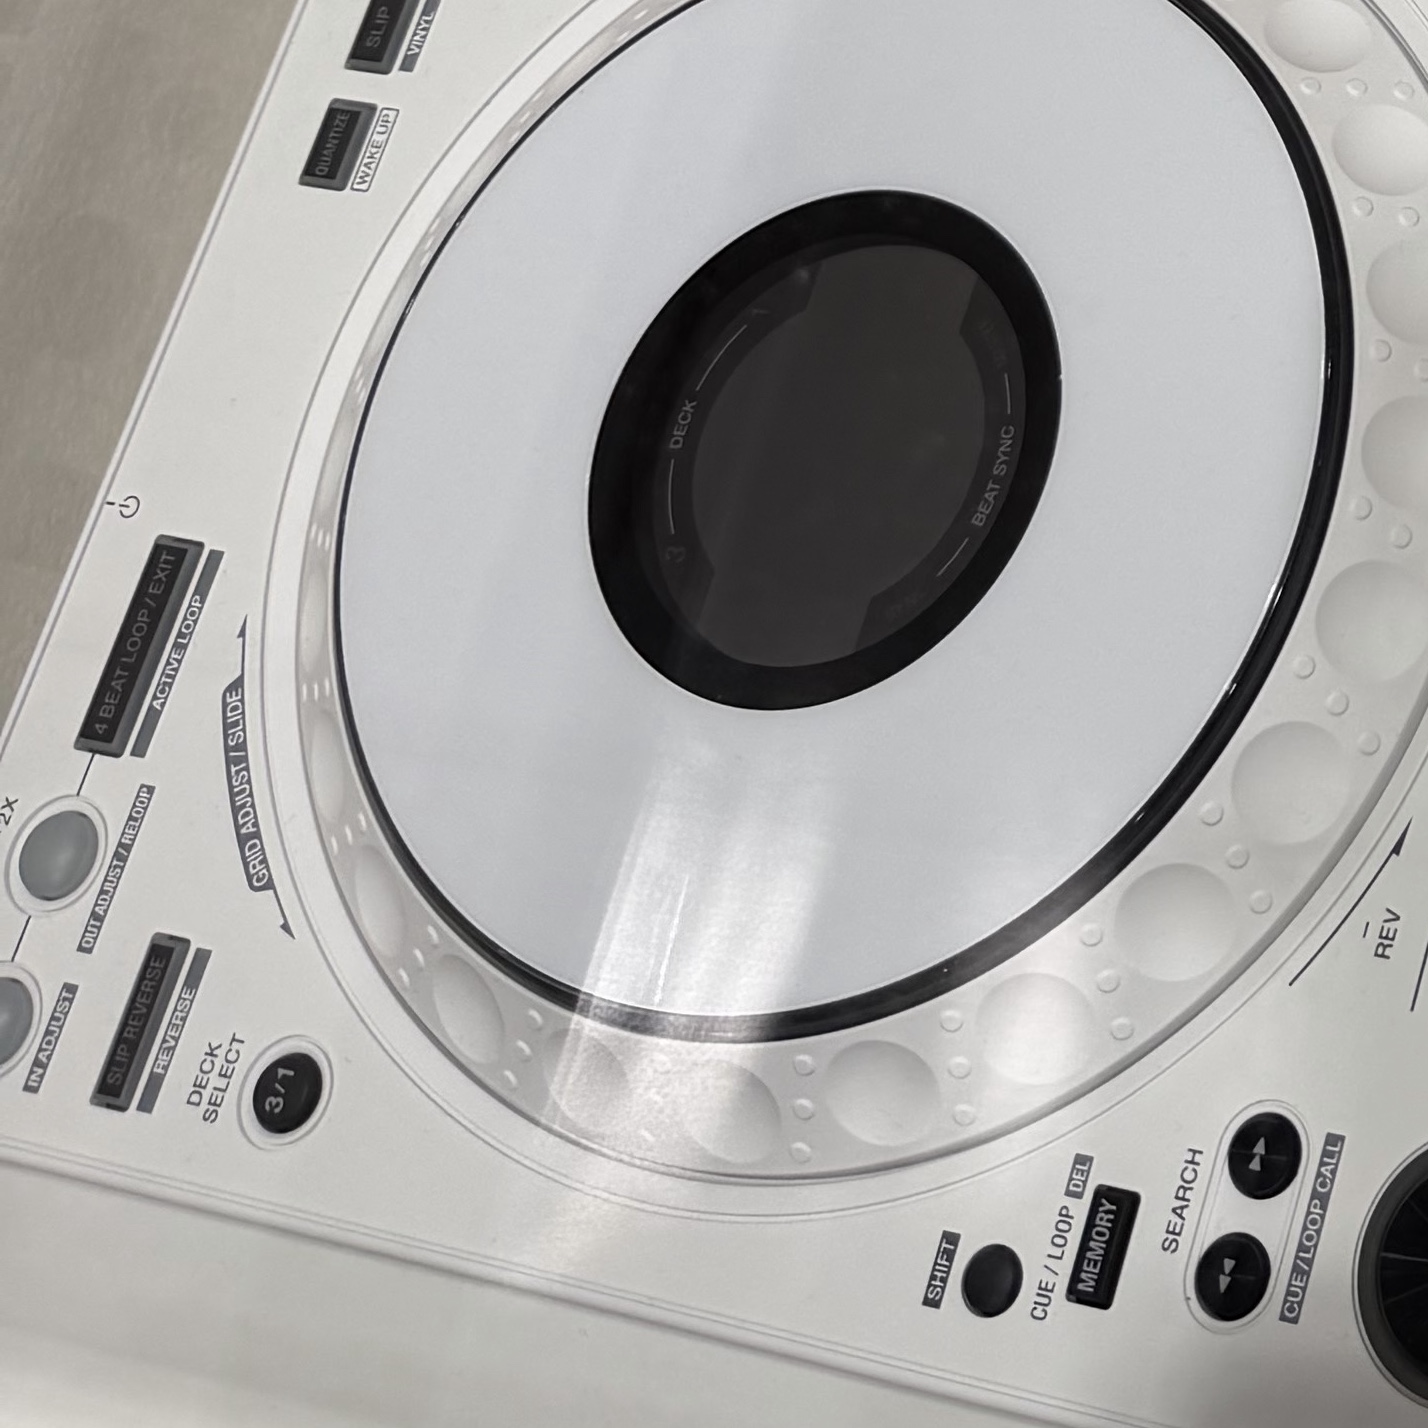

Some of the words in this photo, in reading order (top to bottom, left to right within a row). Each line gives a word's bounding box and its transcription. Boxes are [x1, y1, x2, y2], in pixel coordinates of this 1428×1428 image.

[406, 11, 435, 57] VINYL
[315, 110, 349, 176] QUANTIZE
[356, 139, 384, 187] WAKE
[376, 112, 394, 136] UP
[155, 986, 197, 1075] REVERSE
[185, 1040, 224, 1109] DECK
[202, 1031, 247, 1125] SELECT
[264, 1065, 297, 1115] 3/1
[1160, 1147, 1203, 1255] SEARCH
[926, 1238, 957, 1301] SHIFT
[1077, 1198, 1119, 1292] MEMORY
